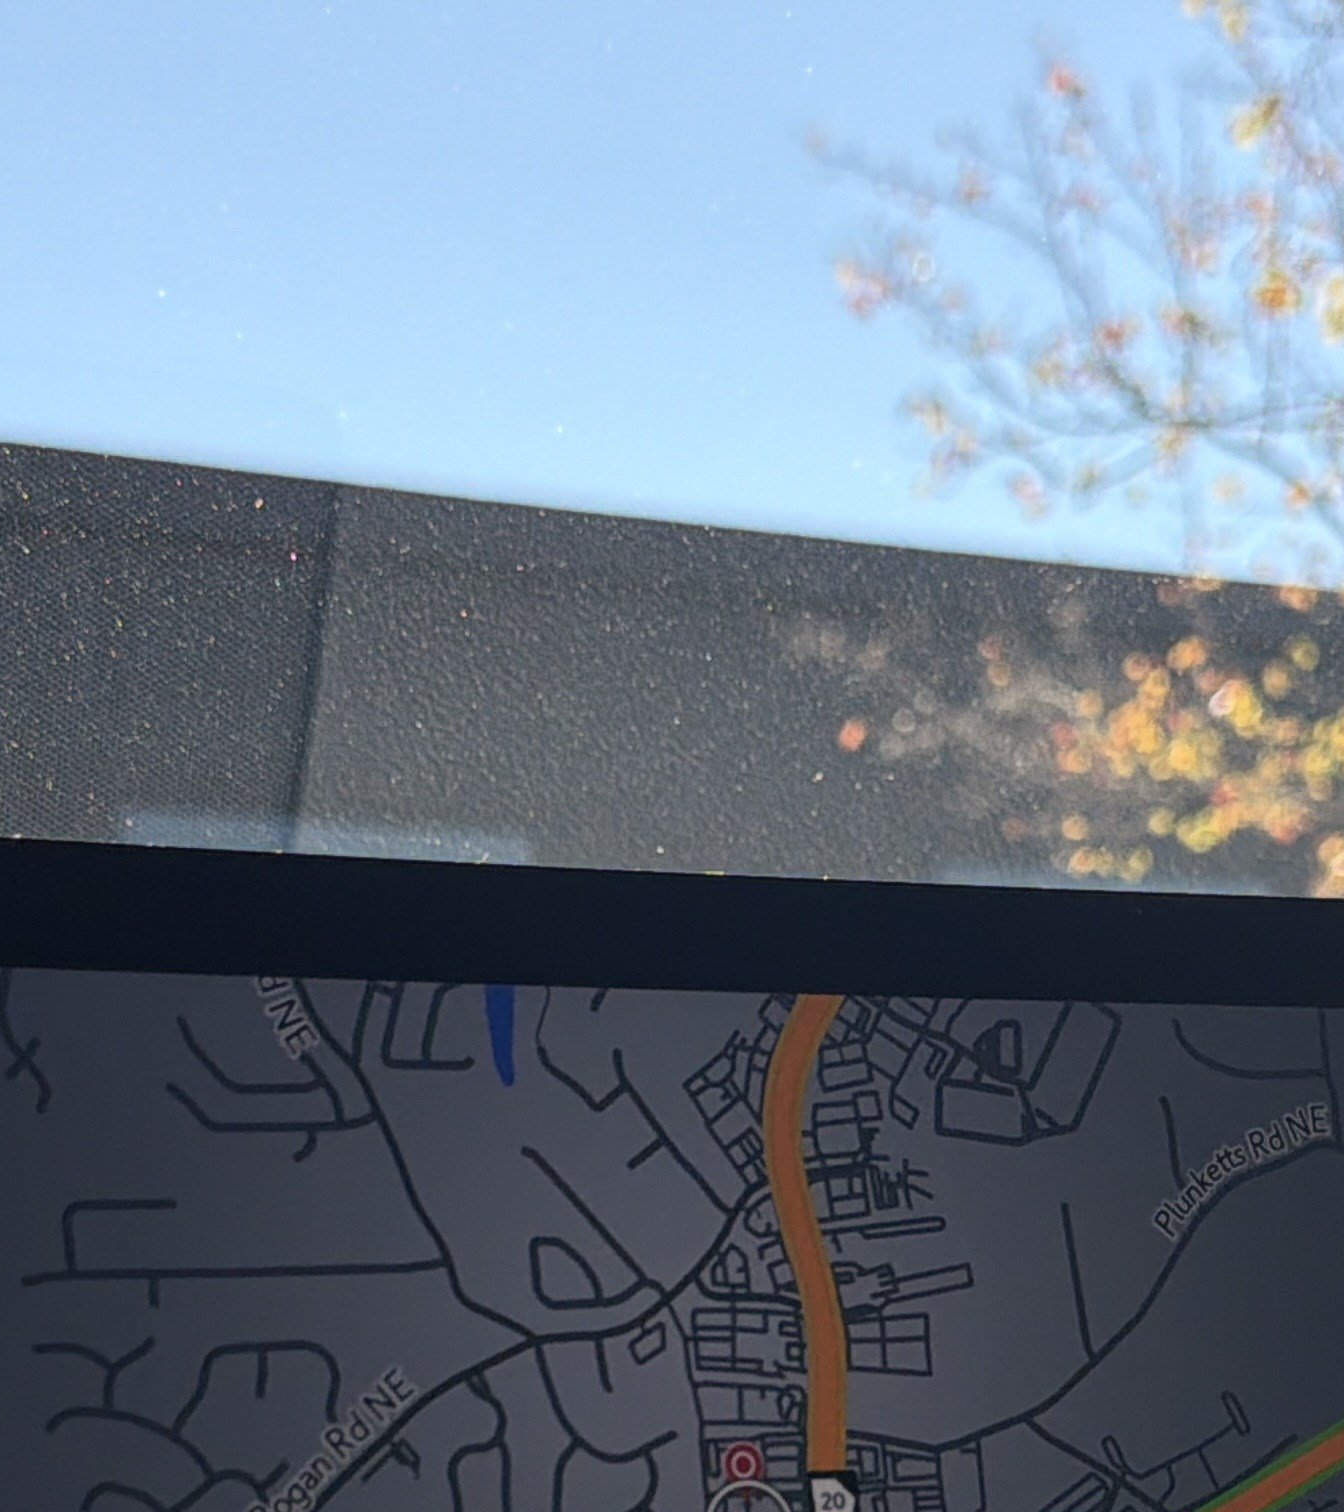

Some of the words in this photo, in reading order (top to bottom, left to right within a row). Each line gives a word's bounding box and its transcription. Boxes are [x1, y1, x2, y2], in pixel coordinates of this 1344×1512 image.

[268, 999, 318, 1055] NE
[1155, 1147, 1246, 1238] Plunketts
[1247, 1122, 1285, 1160] Rd
[1285, 1105, 1328, 1142] NE
[324, 1410, 370, 1460] Rd
[363, 1368, 415, 1421] NE
[820, 1492, 847, 1511] 20
